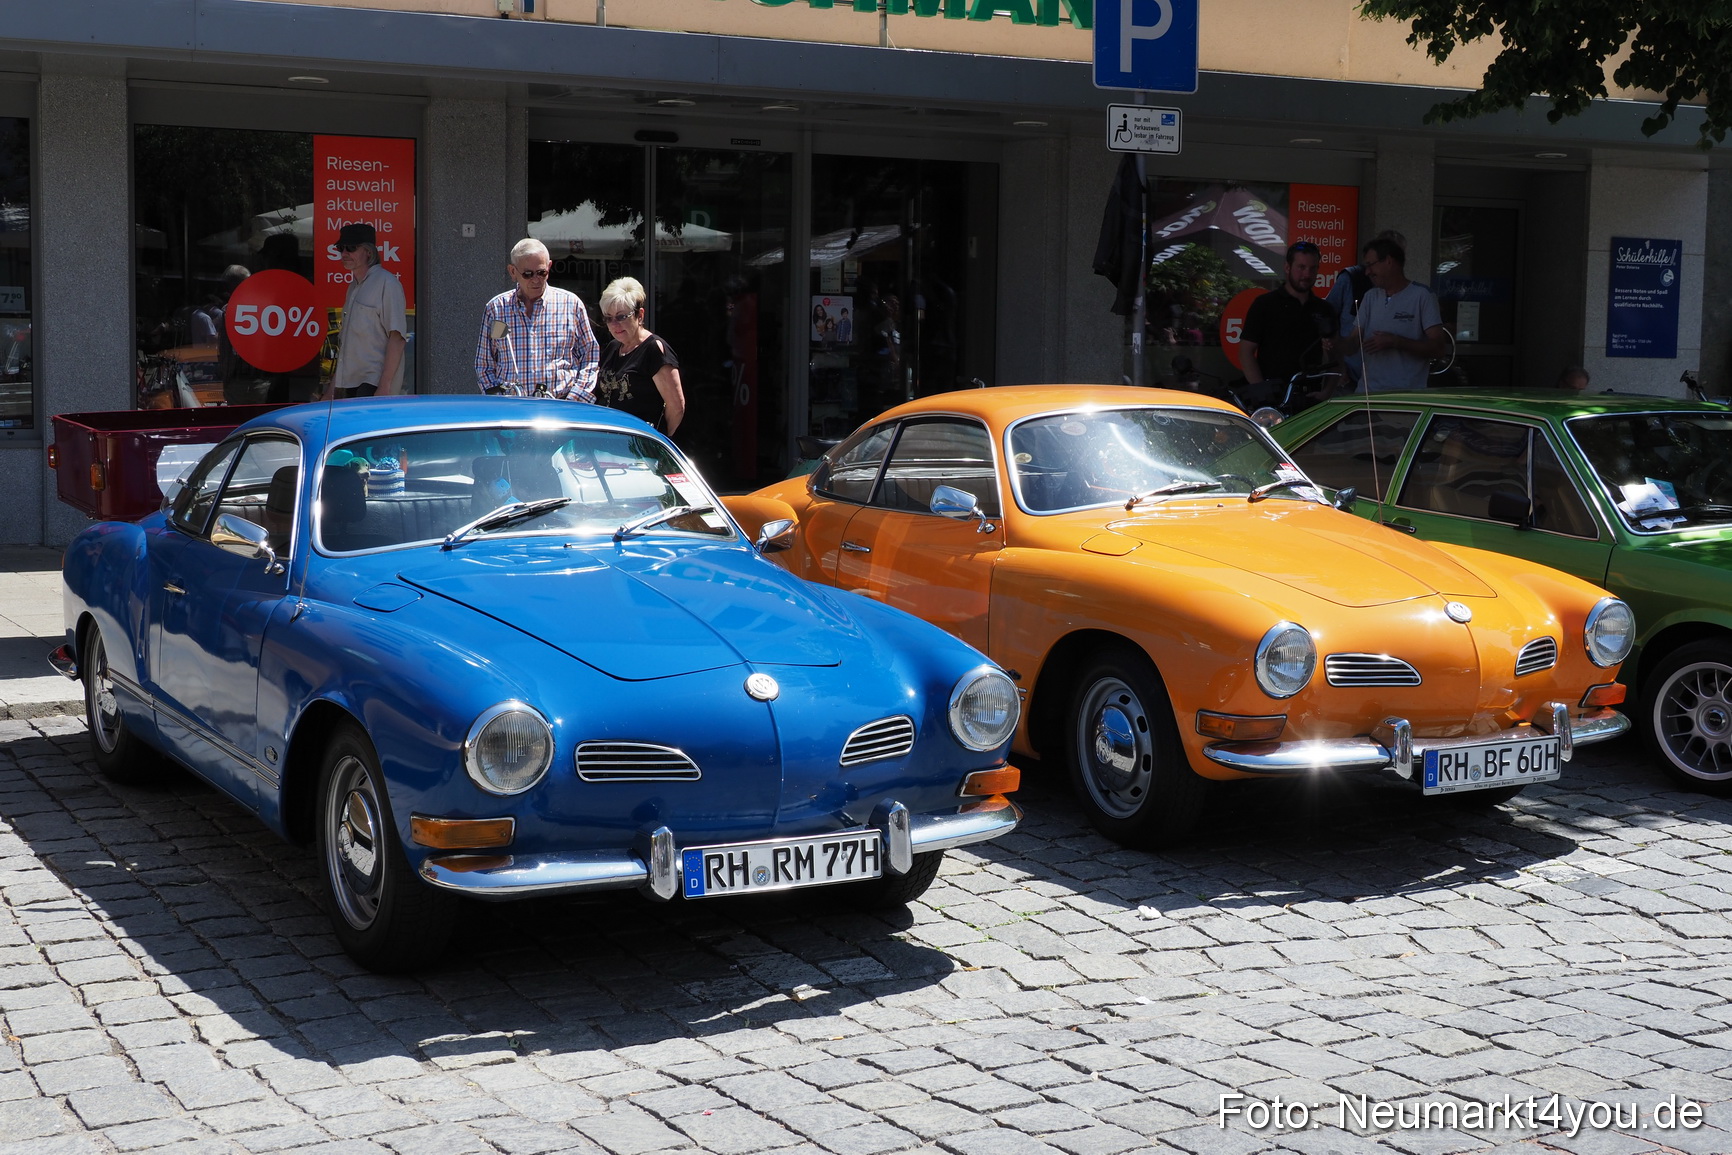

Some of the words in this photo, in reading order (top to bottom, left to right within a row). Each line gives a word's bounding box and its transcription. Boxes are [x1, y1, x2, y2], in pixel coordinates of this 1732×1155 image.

[1120, 0, 1173, 73] P
[1156, 133, 1174, 142] Fahrzeug
[327, 156, 389, 171] Riesen-
[326, 179, 394, 192] auswahl
[326, 197, 399, 212] aktueller
[1297, 200, 1340, 213] Riesen-
[1296, 219, 1344, 231] auswahl
[234, 304, 320, 337] 50%
[1428, 773, 1434, 781] D
[1439, 752, 1469, 783] RH
[1484, 748, 1512, 777] BF
[1517, 743, 1558, 774] 60H
[691, 878, 698, 889] D
[705, 851, 749, 889] RH
[773, 845, 815, 882] RM
[823, 838, 879, 877] 77H
